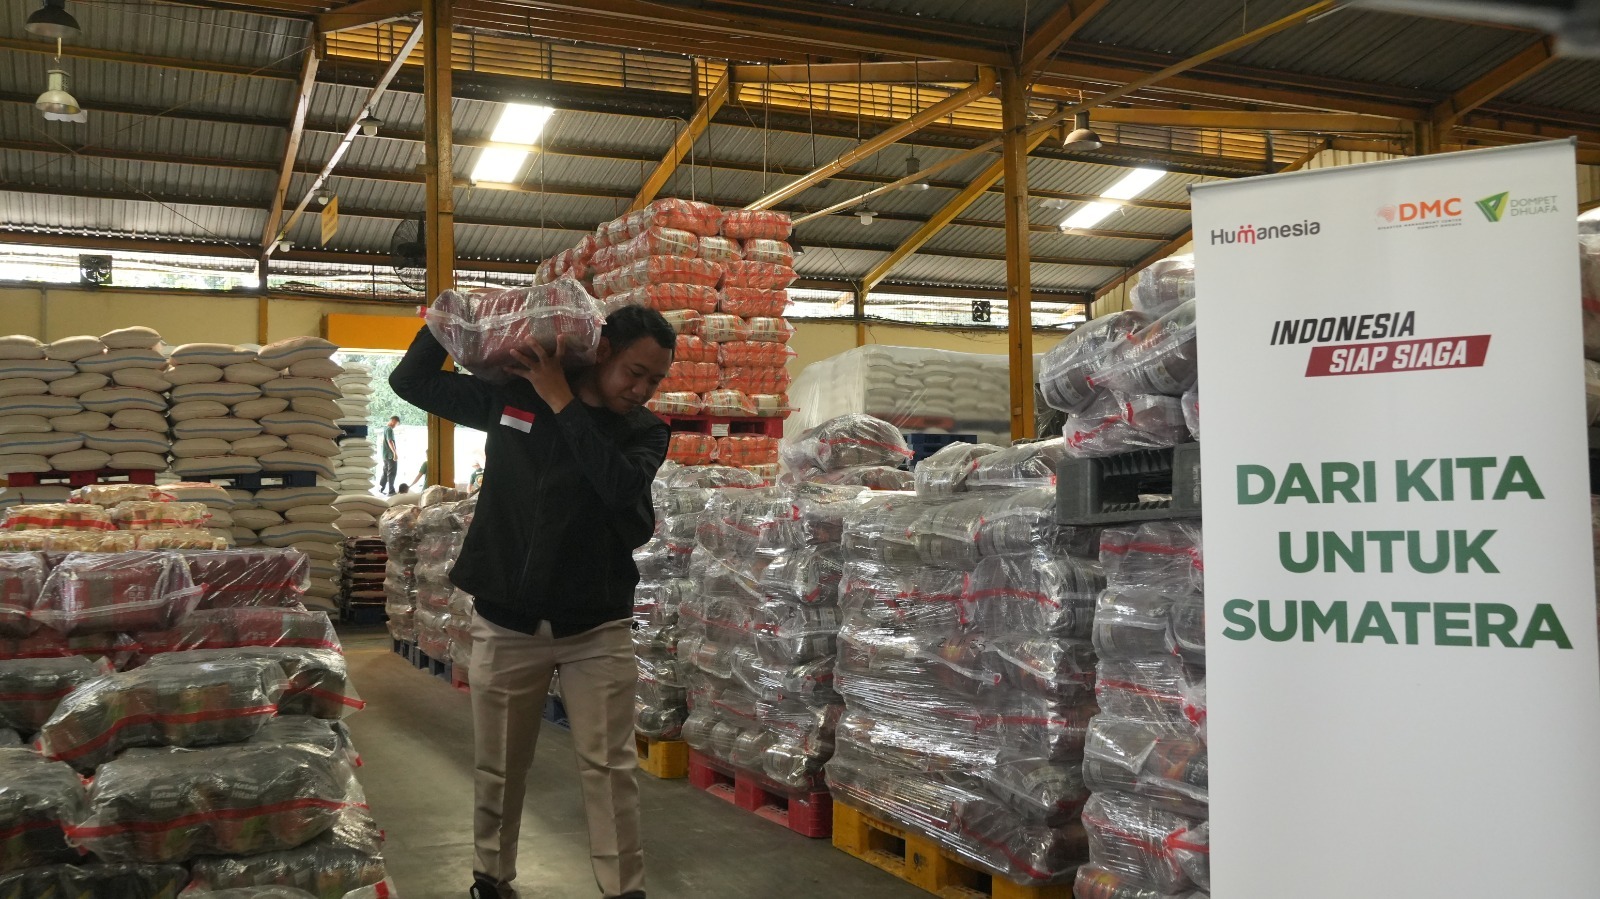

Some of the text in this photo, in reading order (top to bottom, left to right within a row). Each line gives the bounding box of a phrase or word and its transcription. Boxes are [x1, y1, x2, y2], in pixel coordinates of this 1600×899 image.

[1399, 197, 1462, 222] DMC
[1510, 195, 1558, 207] DOMPET
[1510, 204, 1559, 217] DHUAFA
[1211, 221, 1320, 246] Humanesia
[1271, 310, 1415, 346] INDONESIA
[1329, 339, 1467, 373] SIAP SIAGA
[1236, 460, 1377, 505] DARI
[1395, 455, 1546, 503] KITA
[1279, 529, 1501, 574] UNTUK
[1222, 598, 1574, 650] SUMATERA
